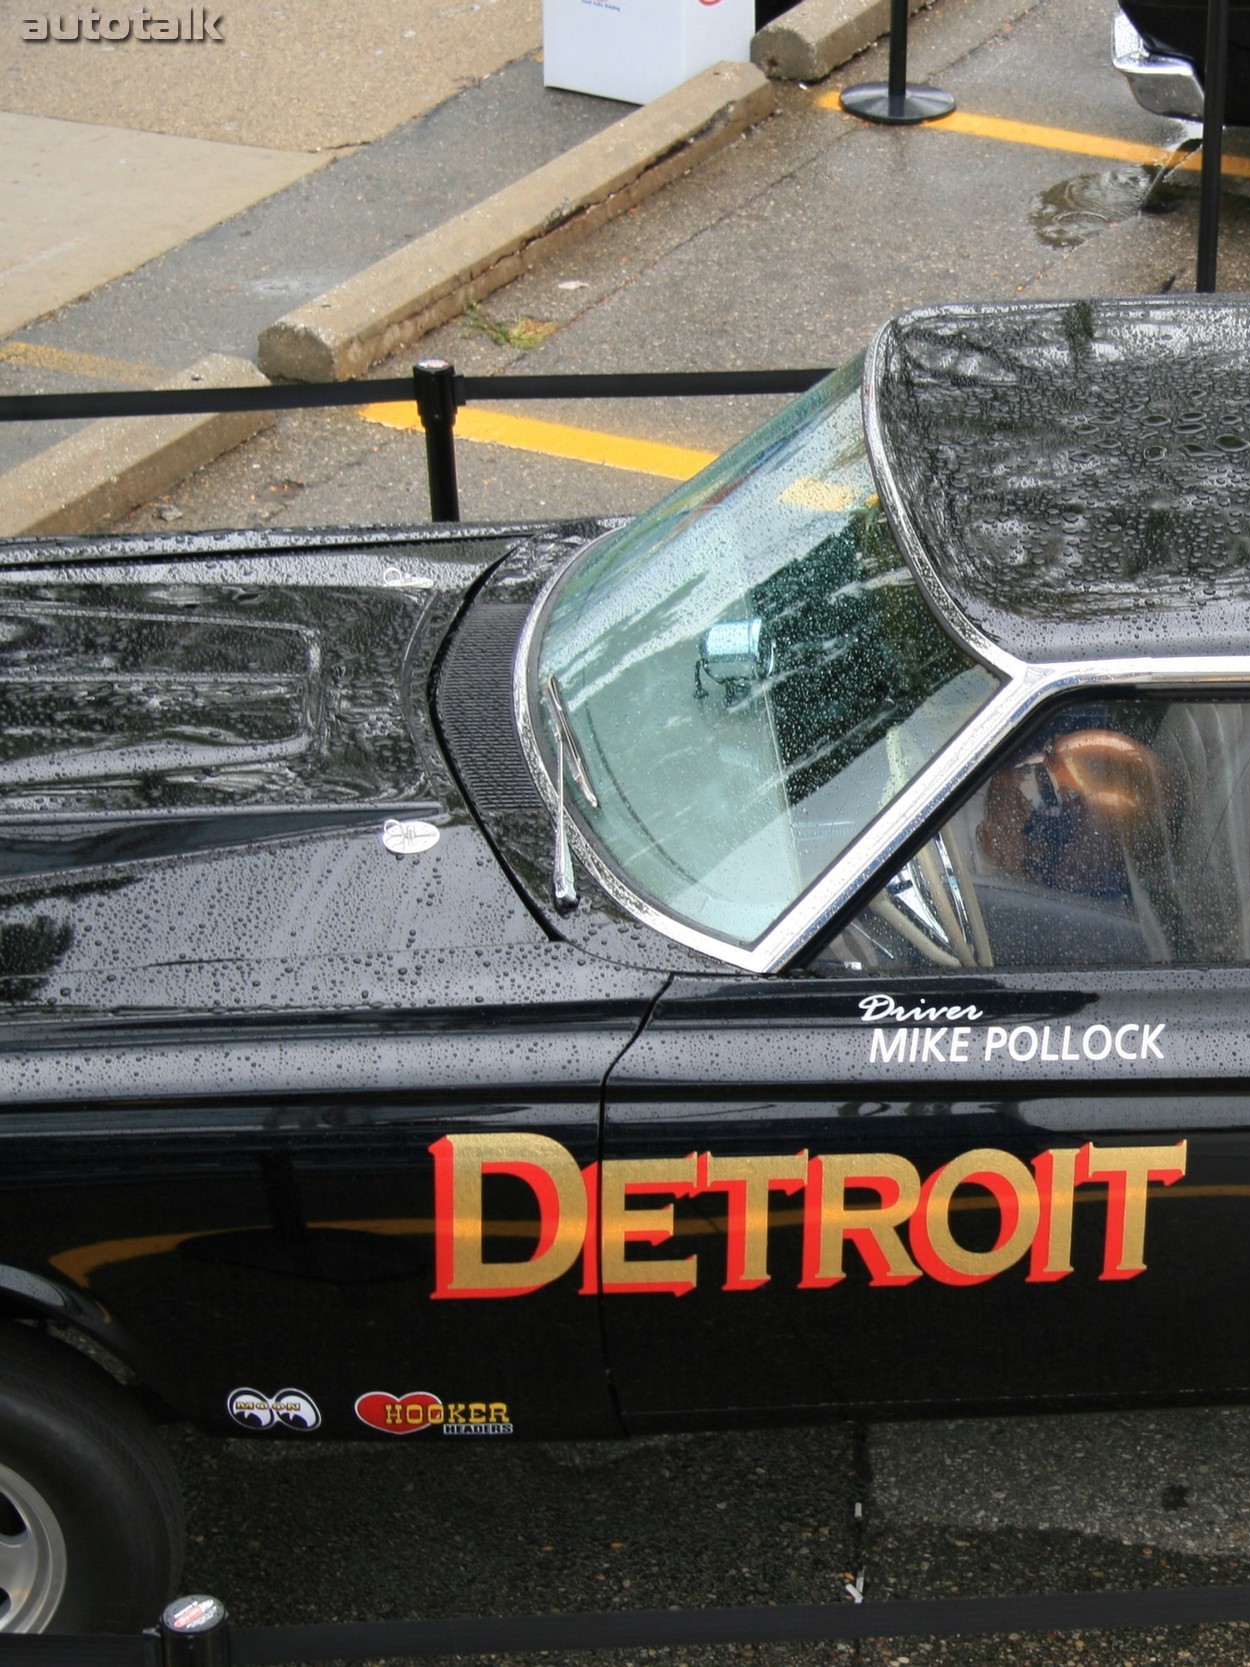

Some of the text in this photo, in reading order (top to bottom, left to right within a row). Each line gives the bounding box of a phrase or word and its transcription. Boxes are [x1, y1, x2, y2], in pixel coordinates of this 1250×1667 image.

[858, 994, 983, 1022] Driver
[869, 1024, 1166, 1063] MIKE POLLOCK
[427, 1131, 1188, 1300] DETROIT
[235, 1402, 301, 1411] MOON
[385, 1402, 510, 1425] HOOKER
[443, 1423, 514, 1435] HEADERS
